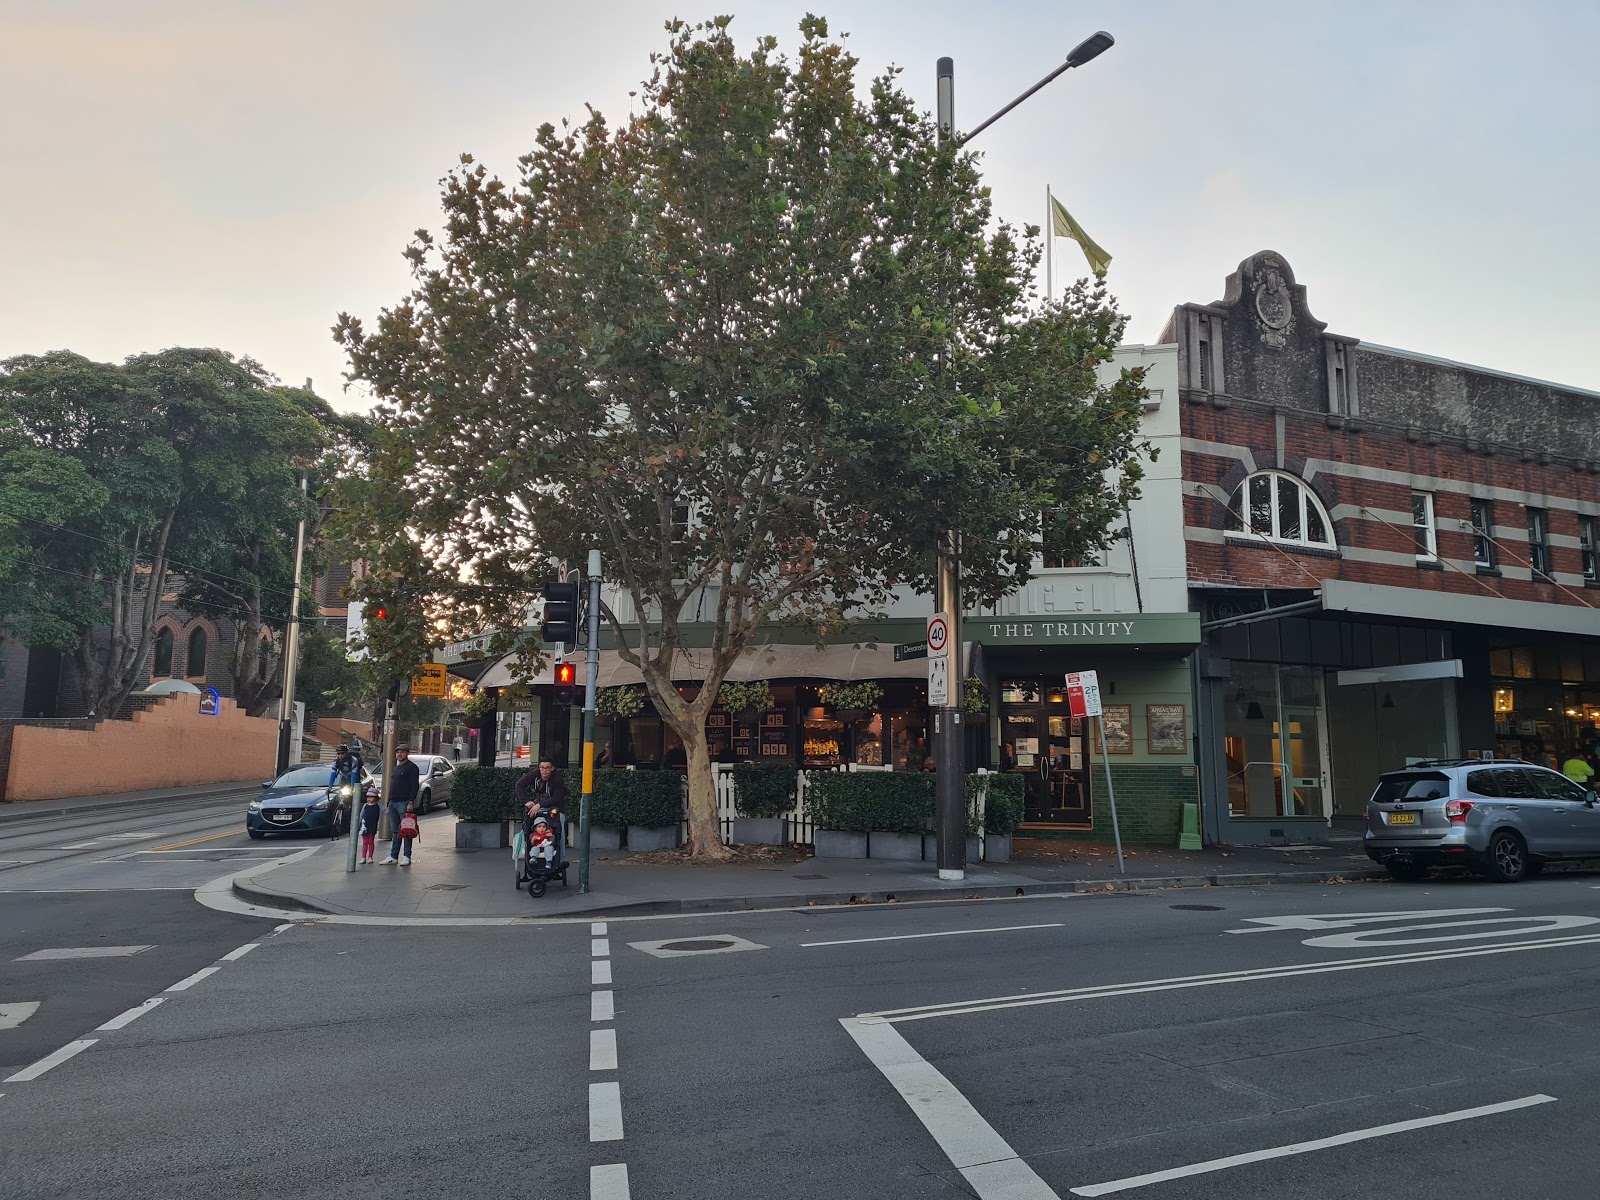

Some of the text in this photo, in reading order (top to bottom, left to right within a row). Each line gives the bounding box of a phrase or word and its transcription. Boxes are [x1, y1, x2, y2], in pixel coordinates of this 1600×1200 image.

[931, 627, 944, 641] 40
[989, 621, 1135, 637] THE TRINITY
[443, 636, 492, 658] THE TRINTY
